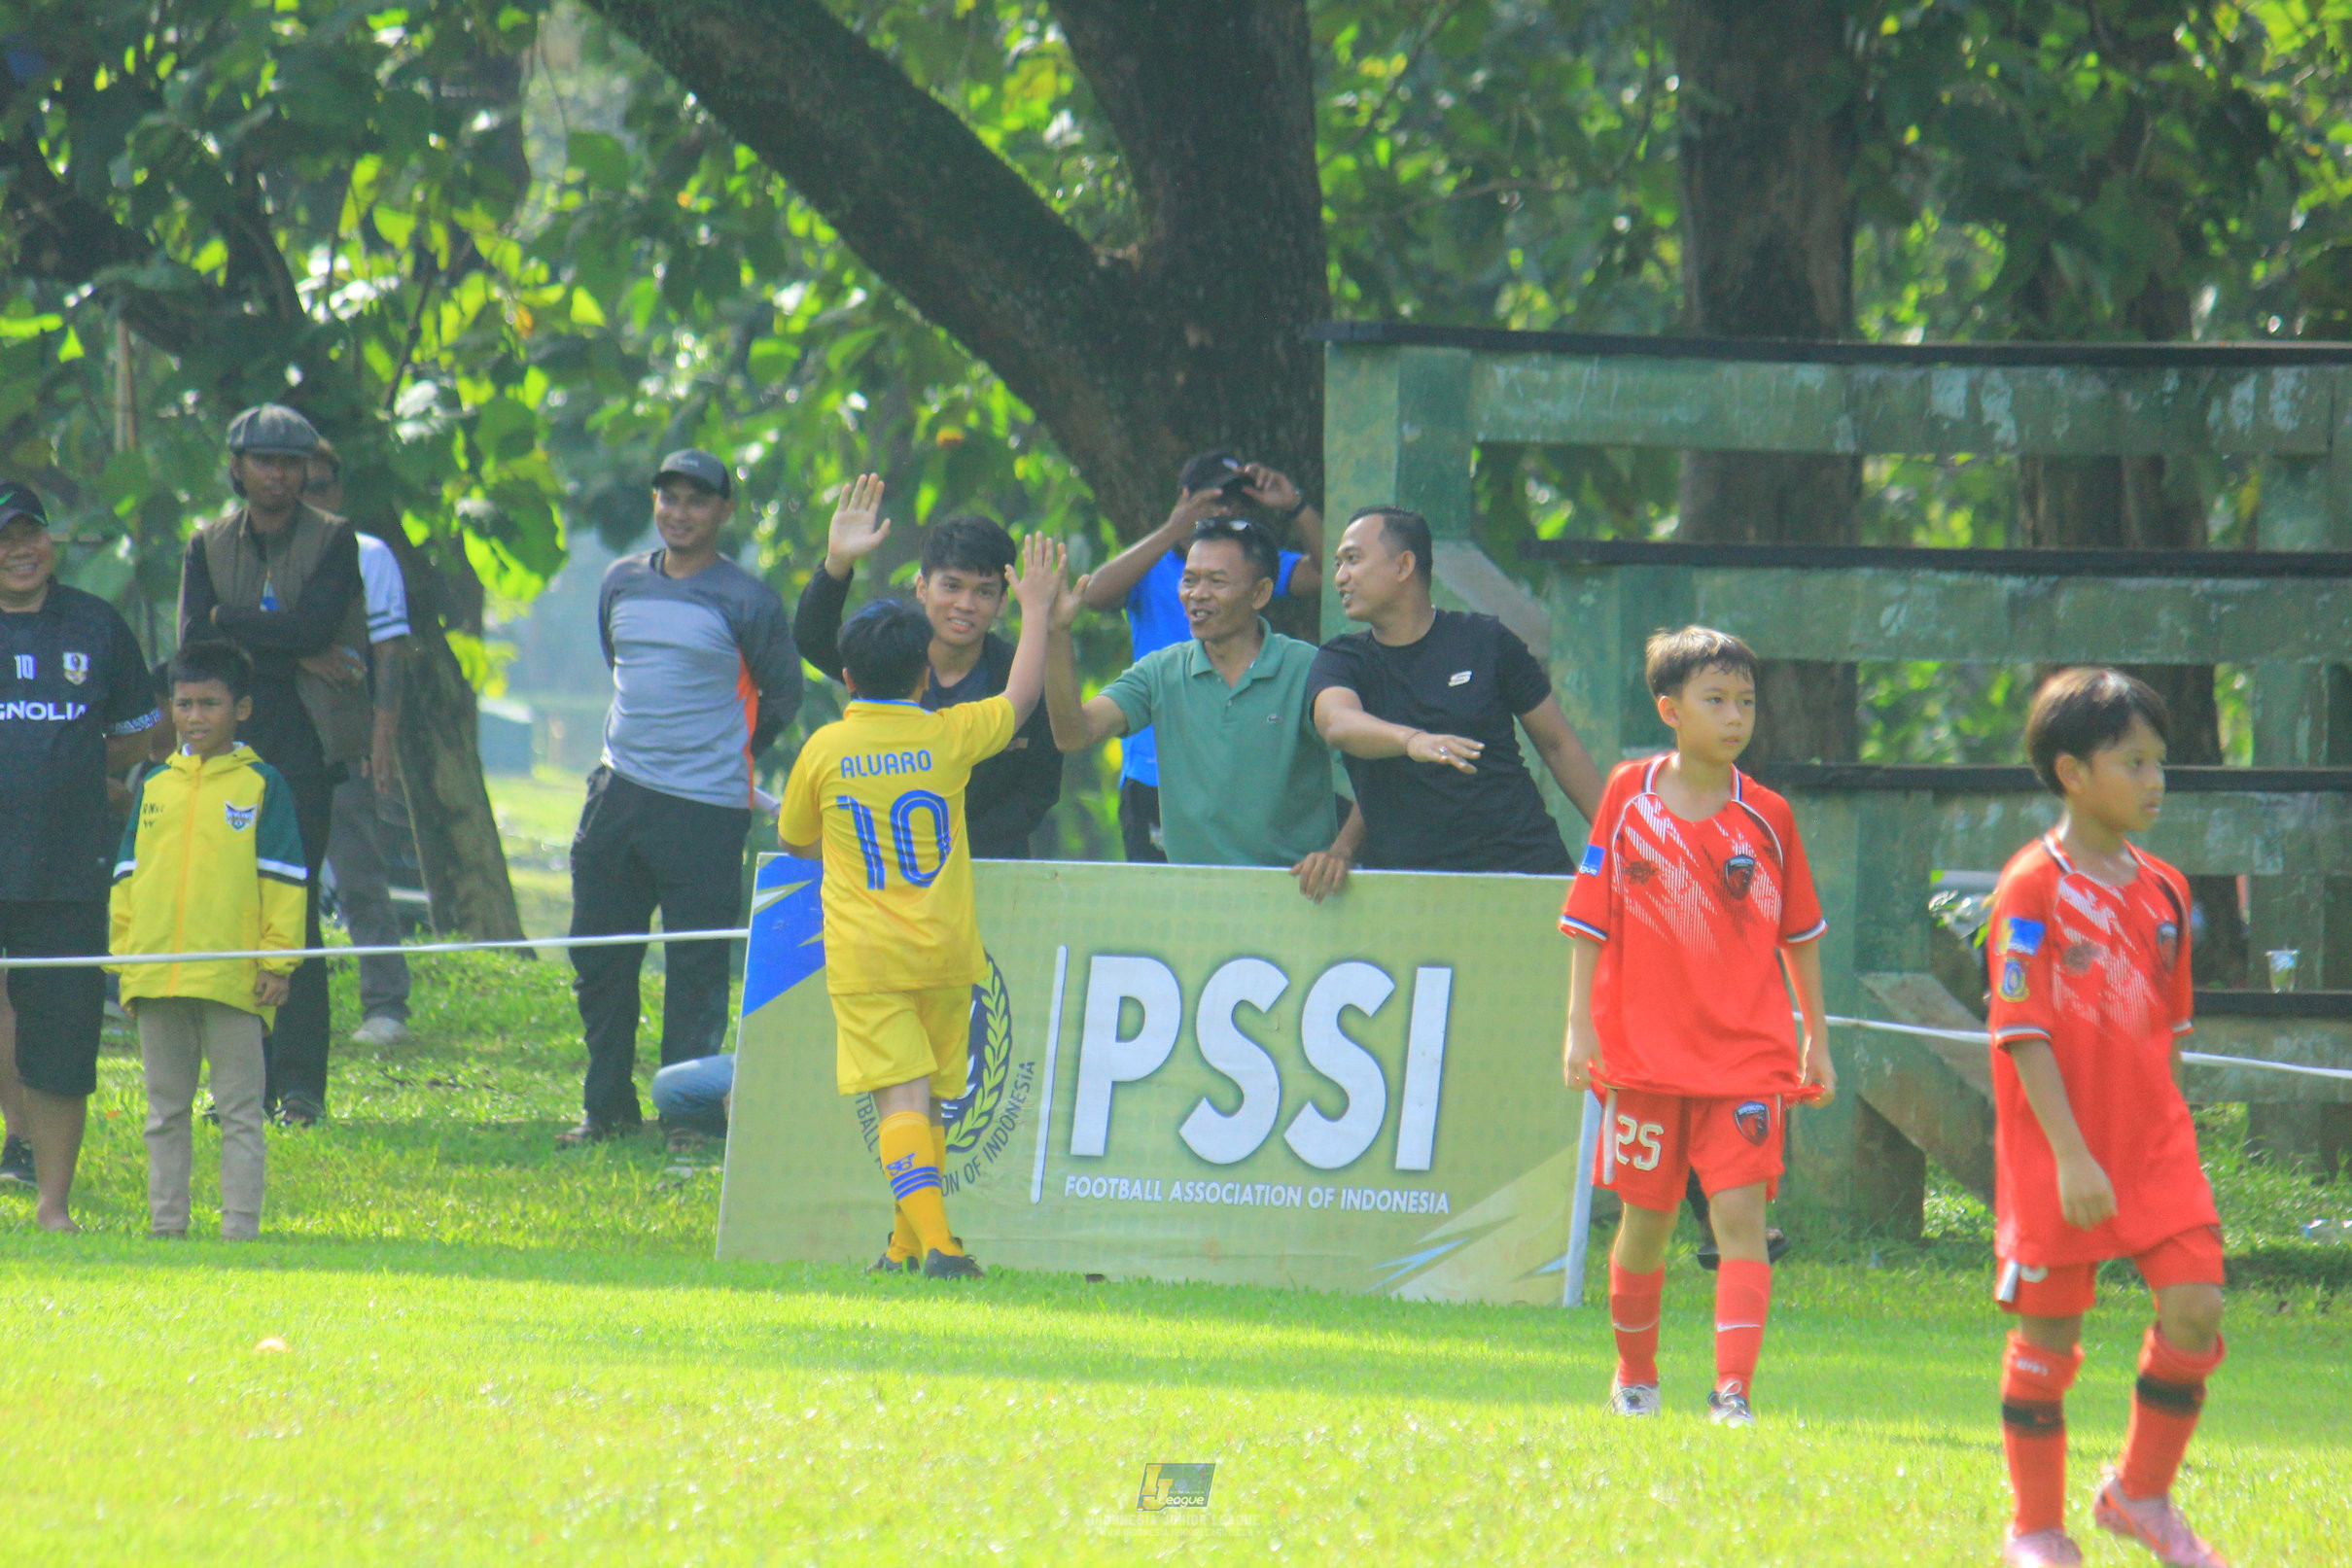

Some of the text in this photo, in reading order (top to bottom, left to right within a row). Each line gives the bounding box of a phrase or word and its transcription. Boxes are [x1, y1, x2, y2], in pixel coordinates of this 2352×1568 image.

[14, 654, 37, 679] 10
[841, 749, 931, 779] ALVARO
[836, 789, 952, 889] 10
[1070, 955, 1453, 1170] PSSI
[964, 1158, 982, 1185] OF
[982, 1061, 1036, 1165] INDONESIA
[1617, 1114, 1665, 1171] 25
[1065, 1175, 1450, 1215] FOOTBALL ASSOCIATION OF INDONESIA
